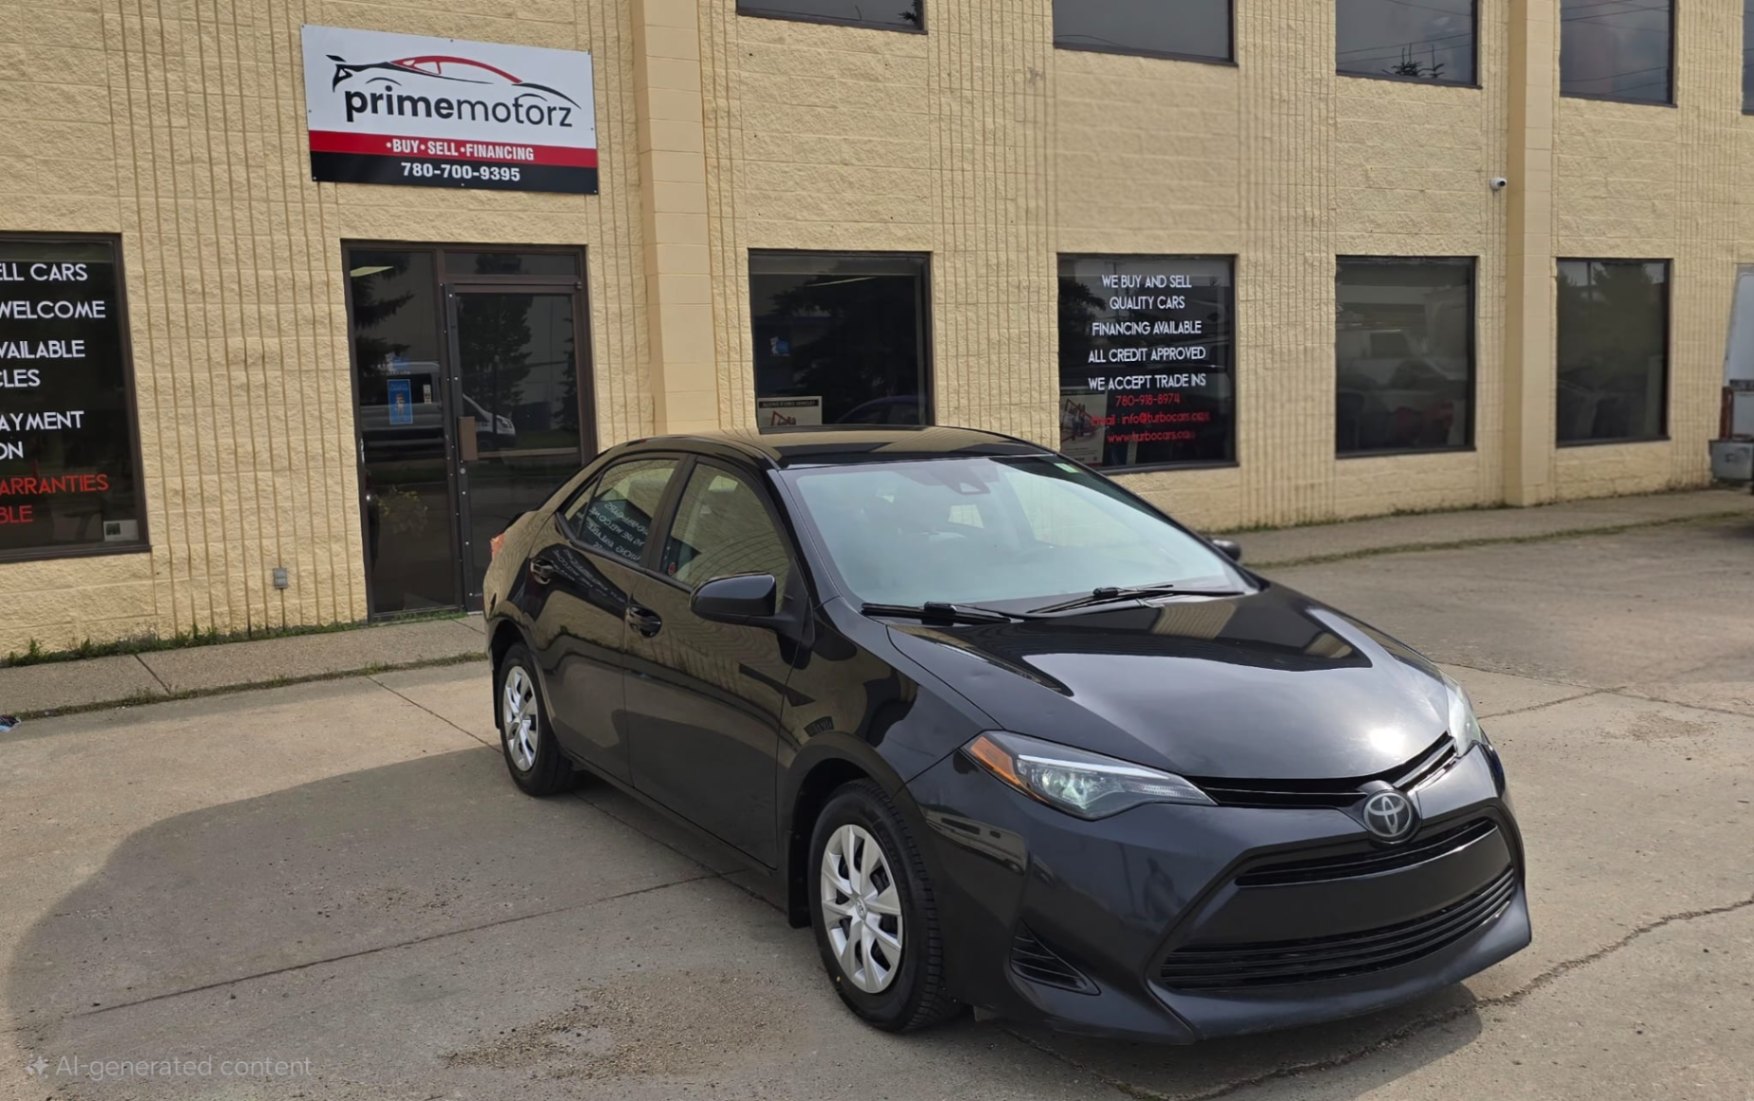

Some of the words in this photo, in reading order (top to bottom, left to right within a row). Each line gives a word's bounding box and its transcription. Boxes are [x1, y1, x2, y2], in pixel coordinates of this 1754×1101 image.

[345, 85, 573, 127] primemotorz
[393, 139, 419, 153] BUY
[428, 141, 458, 156] SELL
[466, 143, 534, 161] FINANCING
[401, 162, 520, 181] 780-700-9395
[0, 262, 25, 281] LL
[30, 262, 88, 281] CARS
[1101, 275, 1118, 288] WE
[1121, 275, 1142, 288] BUY
[1144, 275, 1166, 288] AND
[1169, 274, 1192, 288] SELL
[1109, 296, 1154, 310] QUALITY
[1157, 296, 1185, 309] CARS
[1092, 322, 1150, 336] FINANCING
[1153, 320, 1202, 335] AVAILABLE
[1088, 349, 1106, 363] ALL
[1109, 348, 1148, 362] CREDIT
[1150, 347, 1206, 361] APPROVED
[0, 369, 41, 387] LES
[1088, 377, 1105, 391] WE
[1108, 376, 1152, 390] ACCEPT
